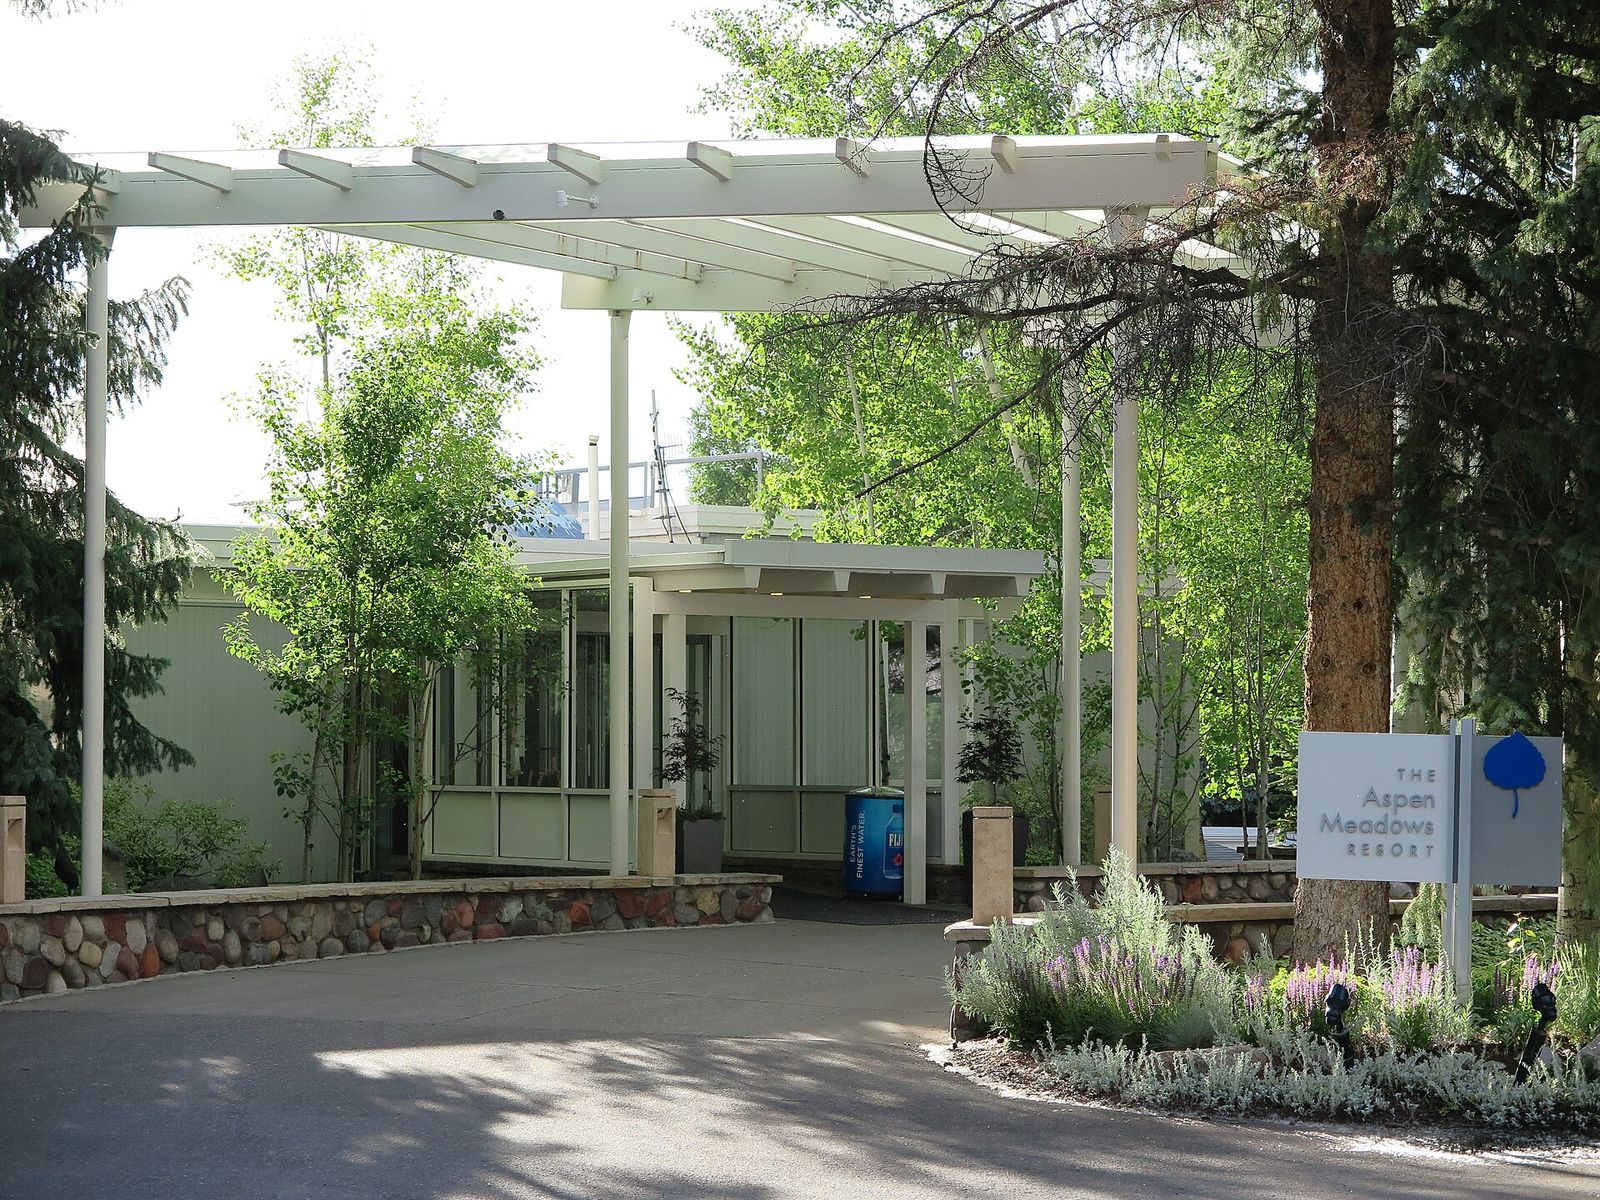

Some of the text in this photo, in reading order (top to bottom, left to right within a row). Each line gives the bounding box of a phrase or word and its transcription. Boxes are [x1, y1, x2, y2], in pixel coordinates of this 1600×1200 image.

[1398, 768, 1436, 783] THE
[1362, 785, 1436, 815] Aspen
[1319, 812, 1435, 835] Meadows
[1347, 843, 1434, 857] RESORT
[856, 847, 865, 878] FINEST
